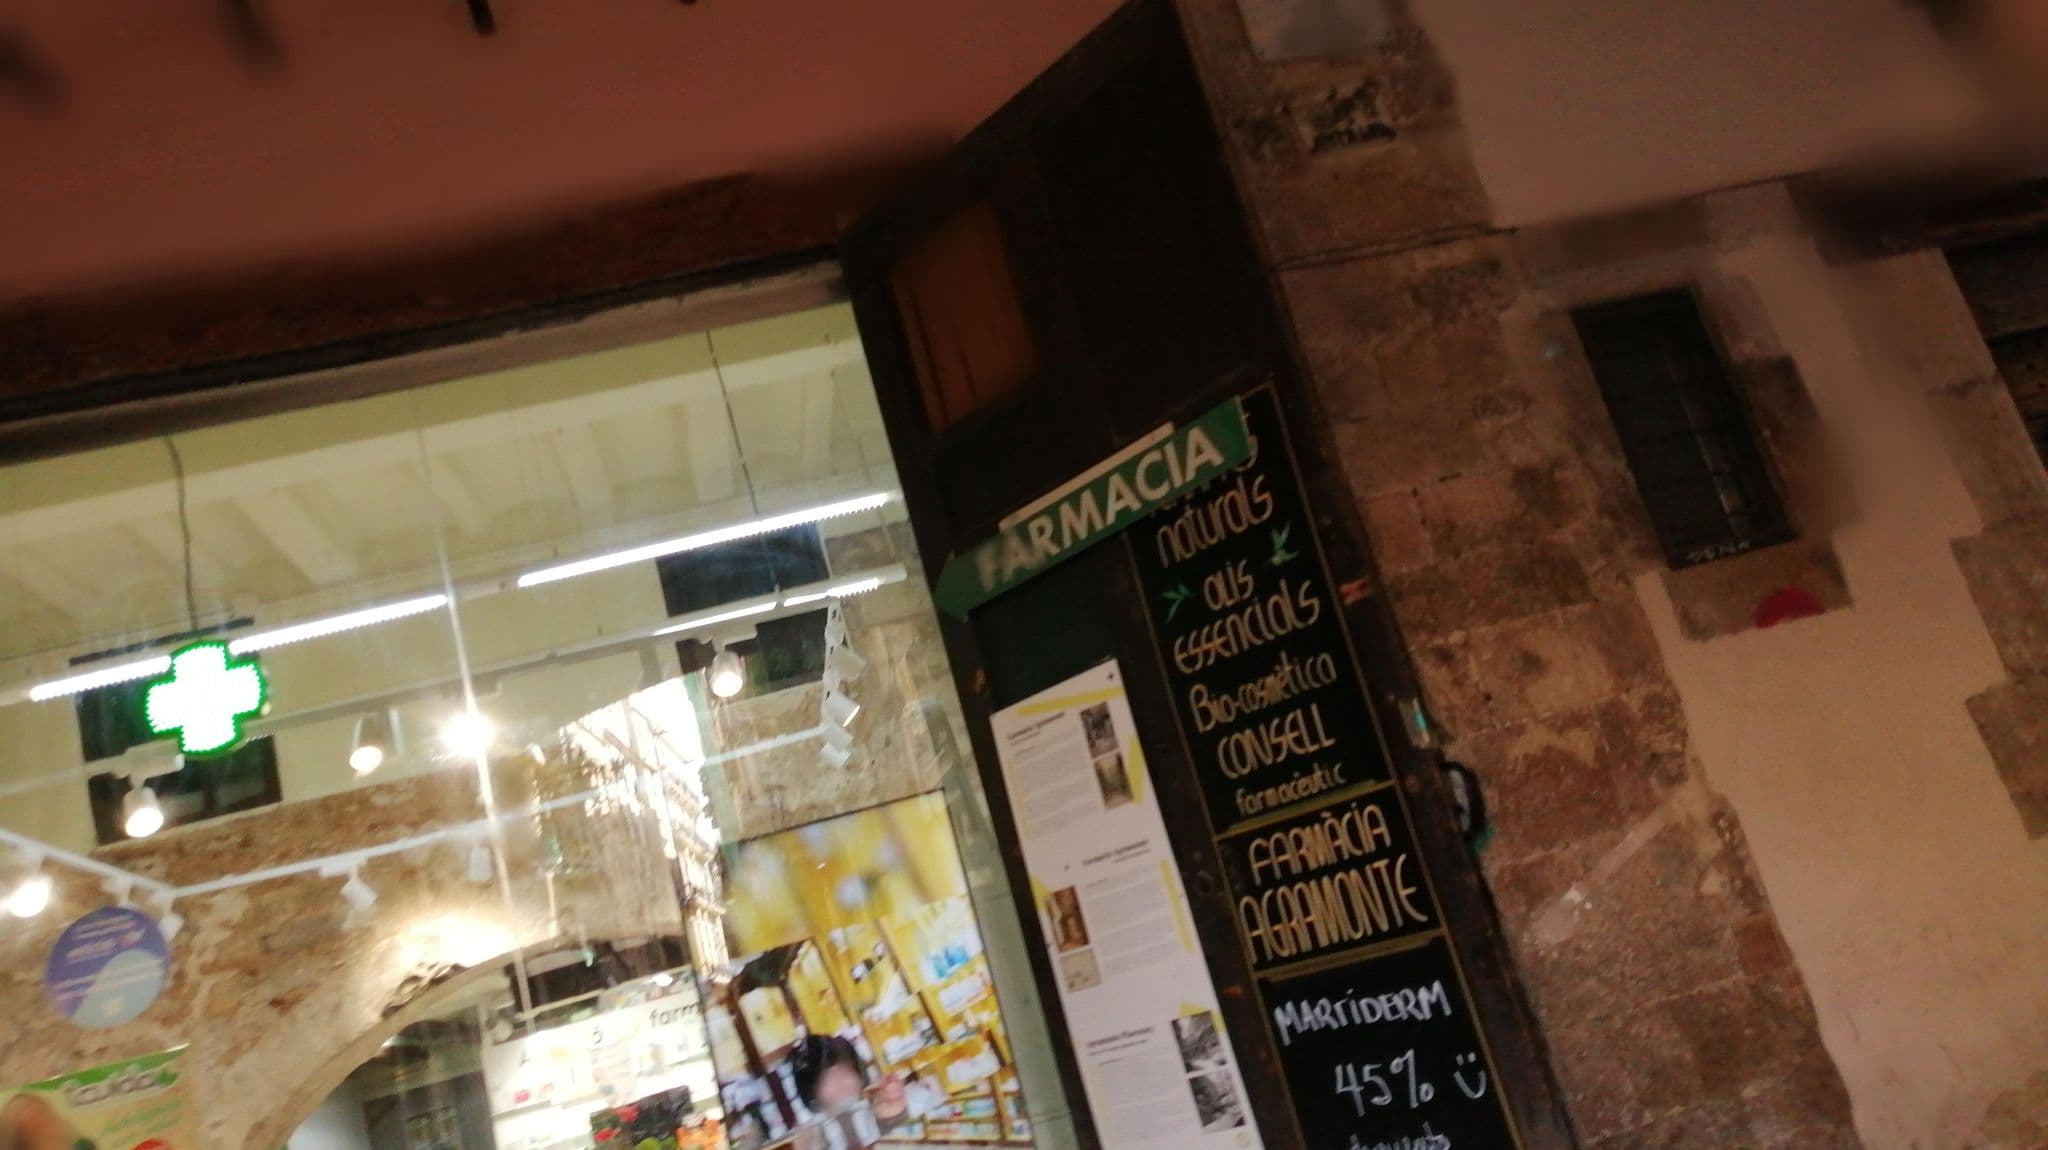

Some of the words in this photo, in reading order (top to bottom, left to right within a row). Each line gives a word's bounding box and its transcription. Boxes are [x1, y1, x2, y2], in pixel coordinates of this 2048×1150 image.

[974, 425, 1224, 593] FARMACIA
[1217, 703, 1337, 780] CONSELL
[1239, 853, 1429, 963] AGRAMONTE
[1334, 1048, 1435, 1118] 45%
